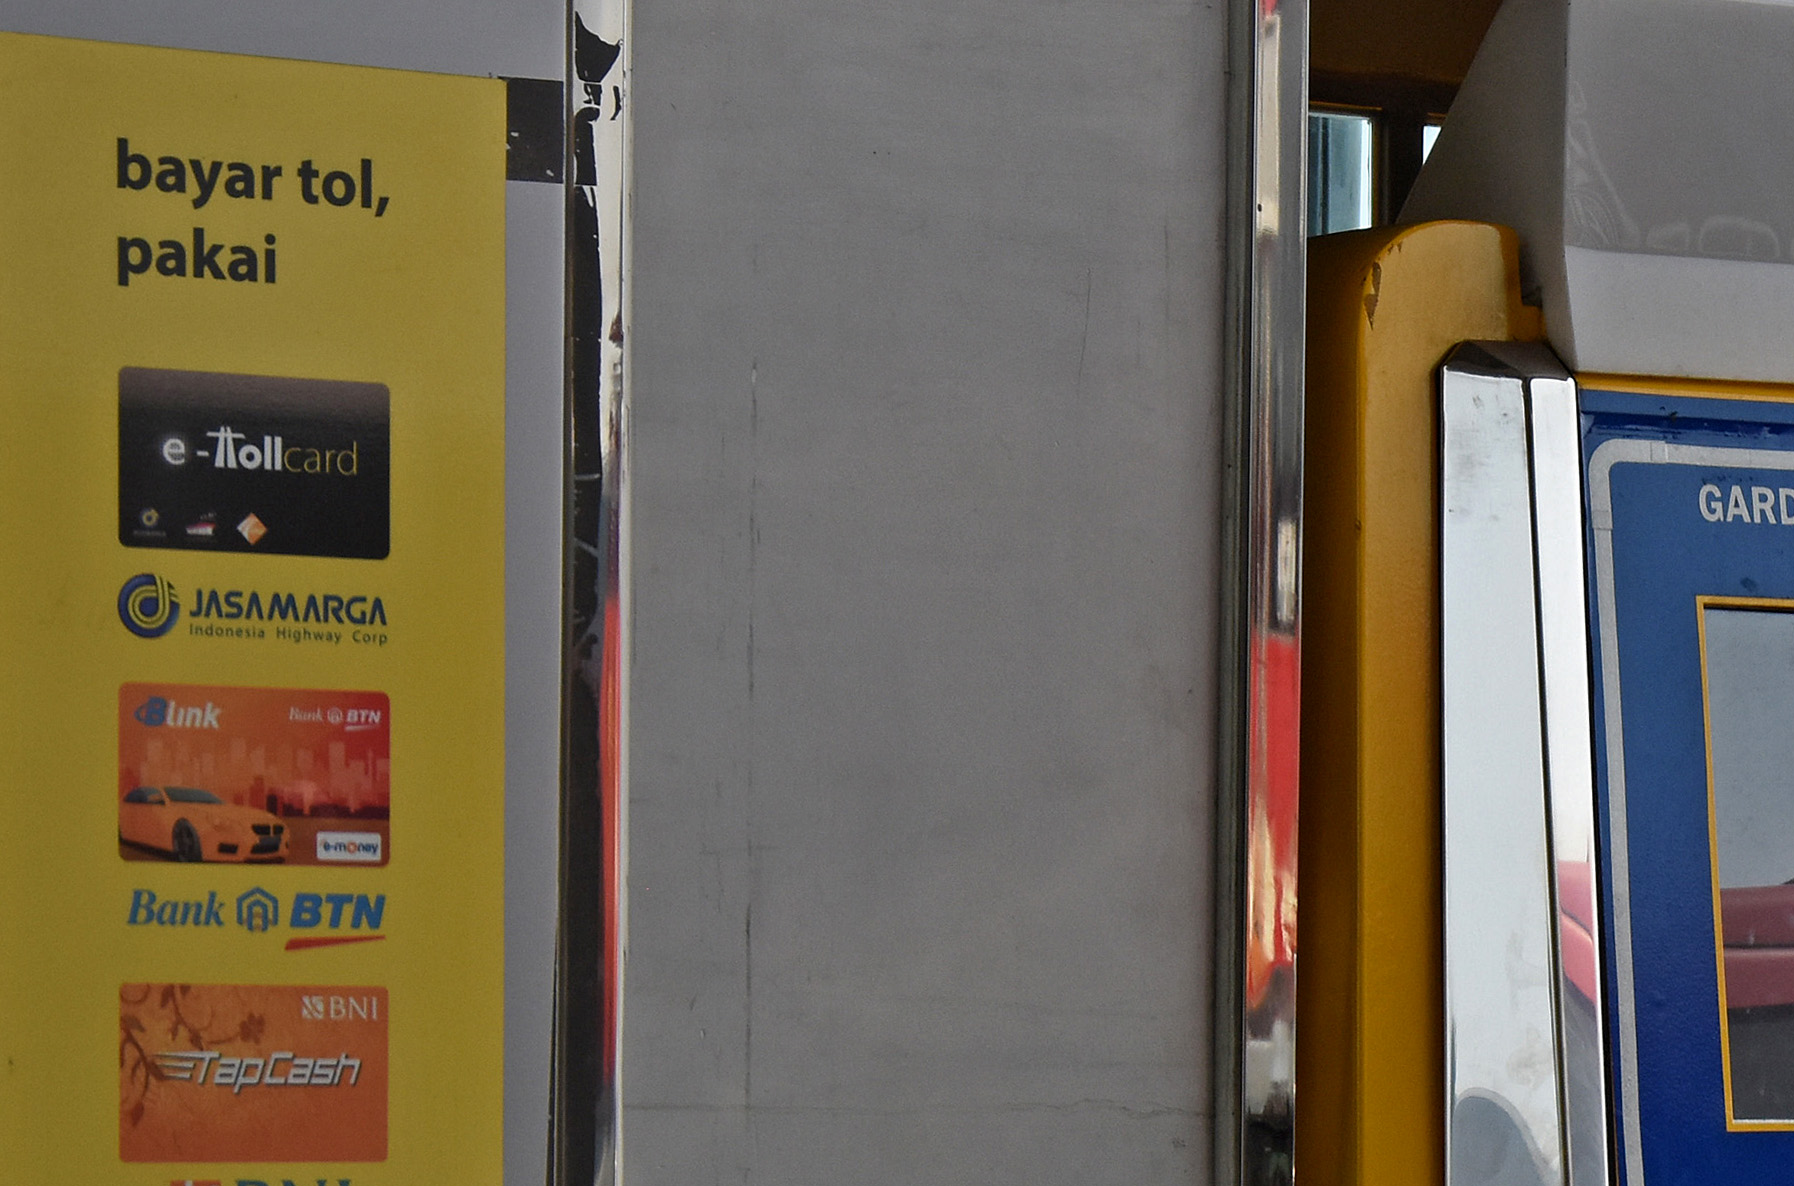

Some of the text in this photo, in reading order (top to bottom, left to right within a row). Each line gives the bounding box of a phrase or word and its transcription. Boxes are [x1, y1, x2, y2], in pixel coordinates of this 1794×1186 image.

[117, 137, 390, 217] bayar tol,
[118, 227, 277, 286] pakai
[190, 623, 388, 646] Indonesia Highway Corp
[346, 709, 381, 724] BTN
[127, 889, 386, 930] Bank BTN
[329, 996, 377, 1021] BNI
[196, 1051, 361, 1094] TapCash
